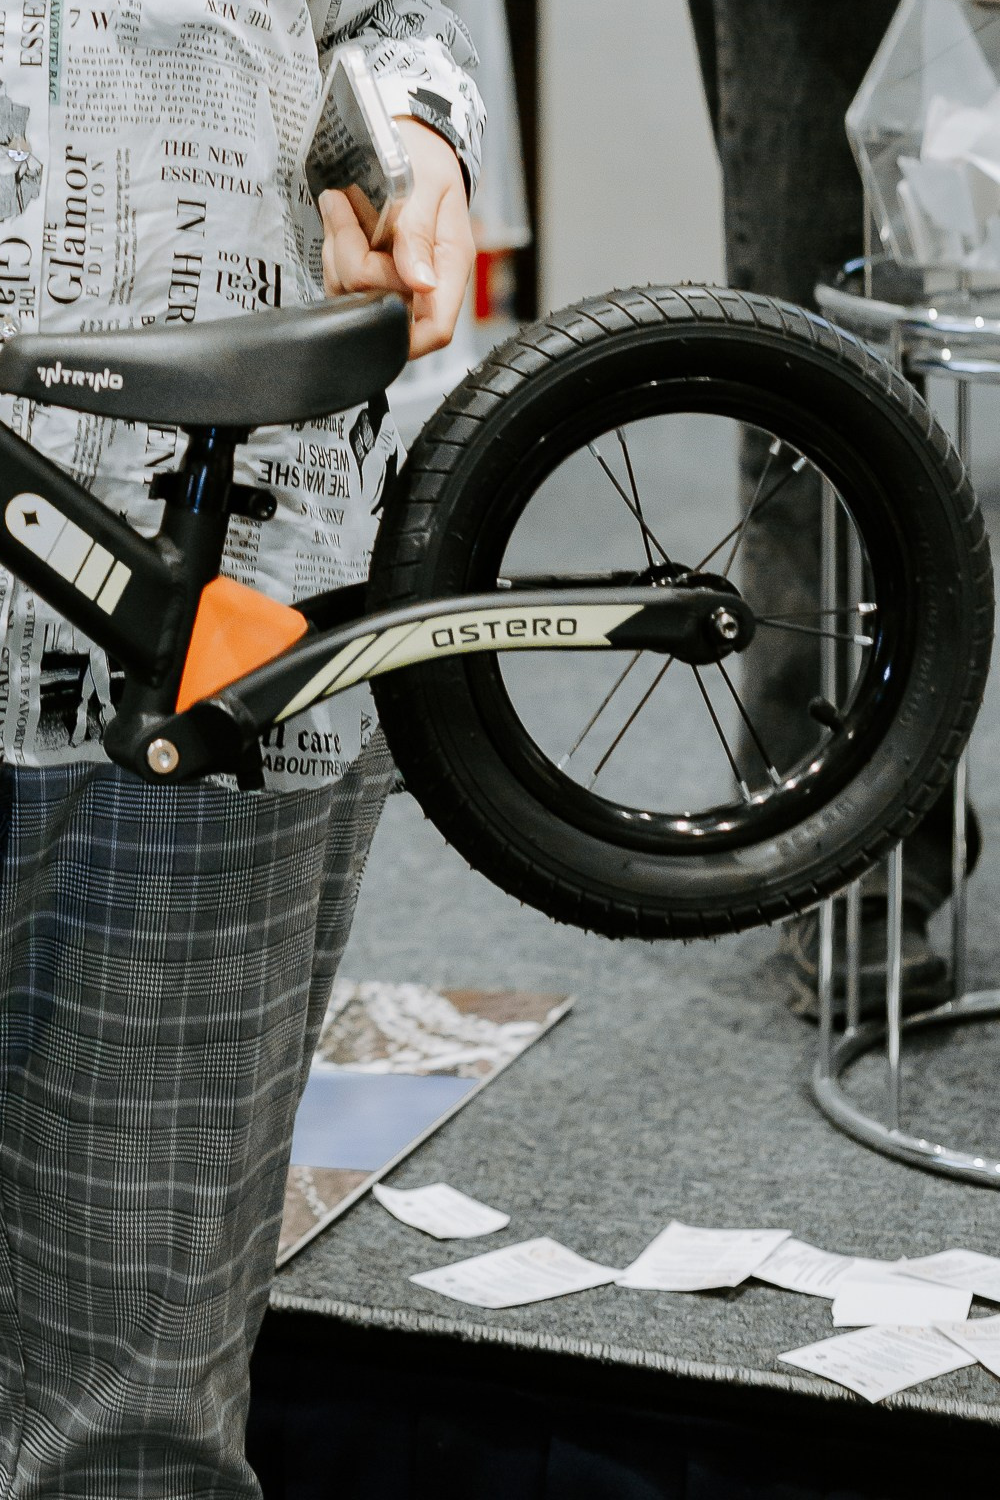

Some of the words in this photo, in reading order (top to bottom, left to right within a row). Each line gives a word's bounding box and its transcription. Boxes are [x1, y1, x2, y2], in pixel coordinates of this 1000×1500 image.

[160, 138, 200, 160] THE
[207, 144, 249, 170] NEW
[160, 165, 265, 198] ESSENTIALS
[46, 144, 89, 305] Glamor
[85, 160, 105, 298] EDITION
[176, 197, 208, 238] IN
[41, 221, 59, 253] THE
[18, 285, 36, 319] THE
[165, 250, 204, 324] HER
[256, 459, 300, 489] SHE
[309, 444, 351, 474] WEARS
[327, 474, 351, 499] THE
[297, 729, 342, 755] care
